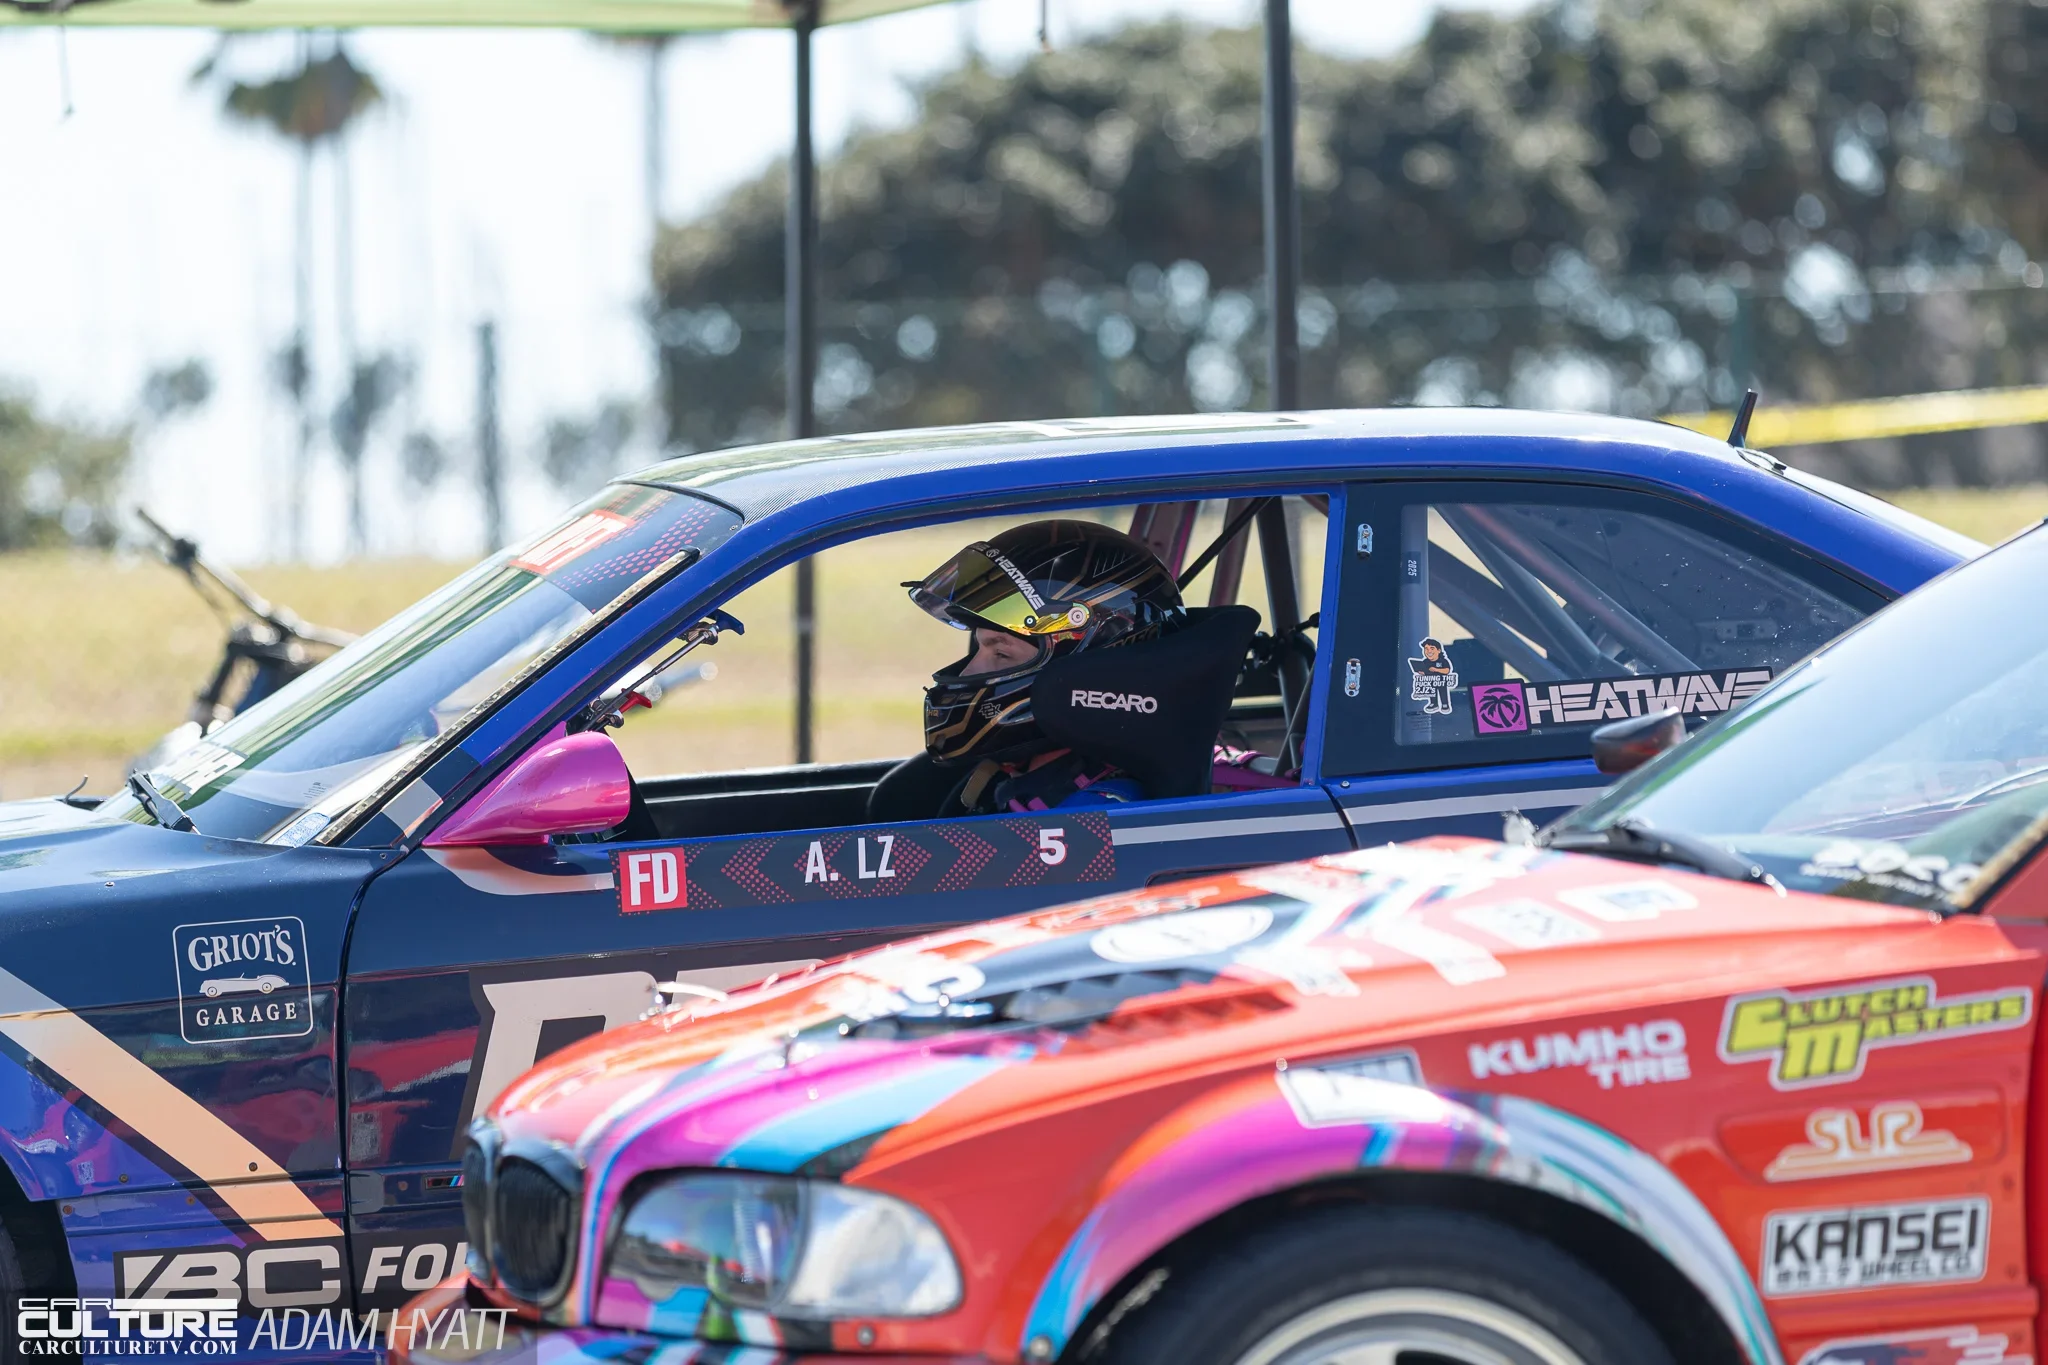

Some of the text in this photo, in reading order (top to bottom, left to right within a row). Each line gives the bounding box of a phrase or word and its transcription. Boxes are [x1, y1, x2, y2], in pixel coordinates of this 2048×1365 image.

[995, 554, 1046, 611] HEATWAVE
[1407, 559, 1417, 577] 2025
[1071, 690, 1158, 713] RECARO
[1525, 671, 1771, 724] HEATWAVE
[628, 828, 1067, 906] FD A. LZ 5
[187, 924, 296, 972] GRIOT'S
[196, 1002, 298, 1027] GARAGE
[1727, 984, 1929, 1053] CLUTCH
[1778, 995, 2026, 1081] MASTERS
[1467, 1019, 1687, 1079] KUMHO
[1588, 1053, 1691, 1089] TIRE
[1811, 1109, 1919, 1155] SLR
[1774, 1208, 1979, 1266] KANSEI
[123, 1242, 469, 1313] BC FO
